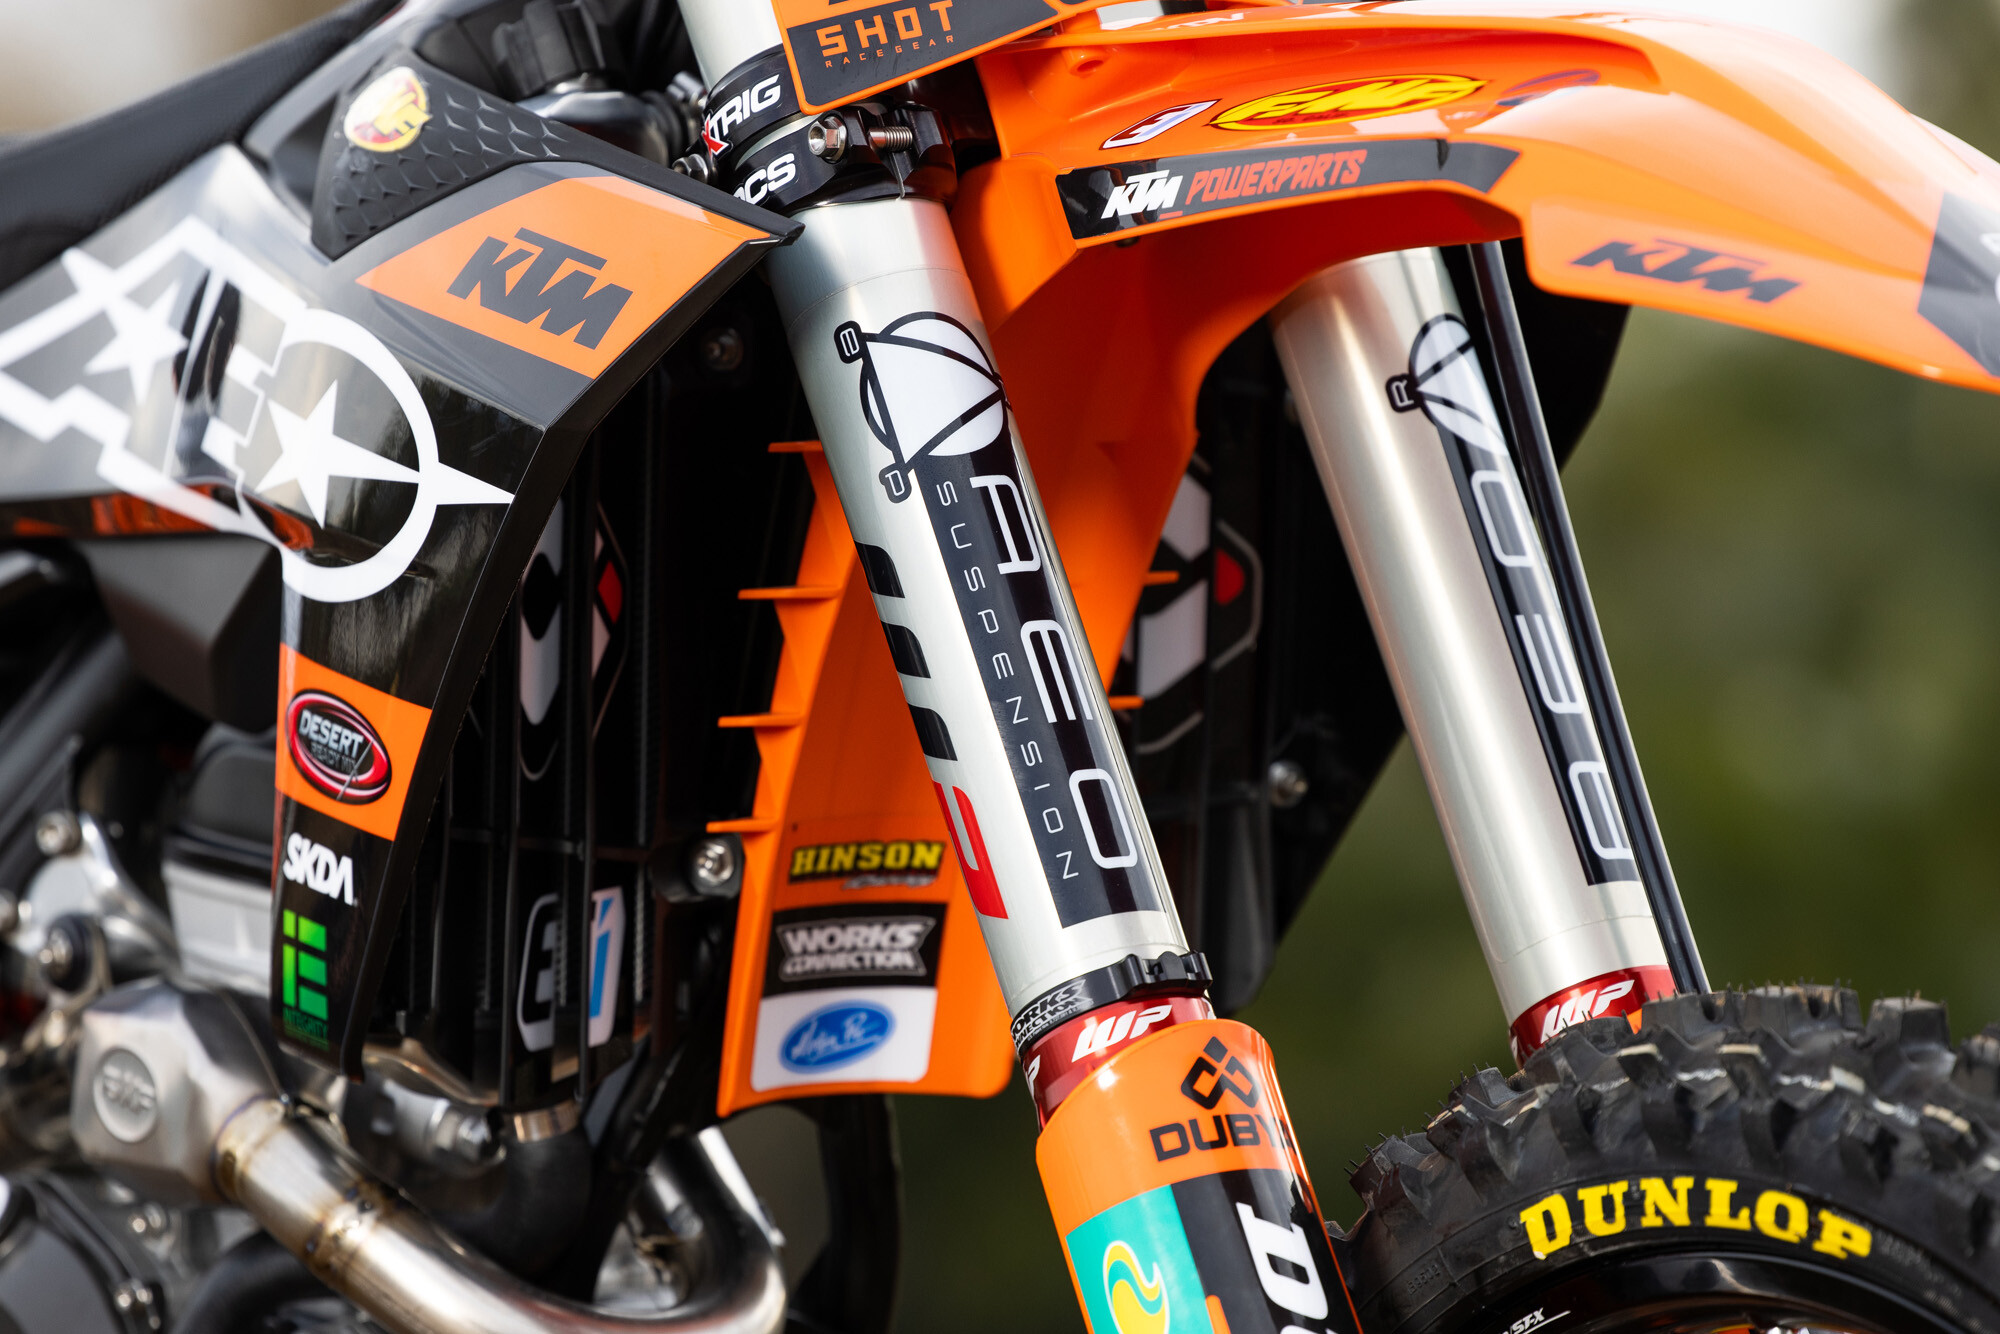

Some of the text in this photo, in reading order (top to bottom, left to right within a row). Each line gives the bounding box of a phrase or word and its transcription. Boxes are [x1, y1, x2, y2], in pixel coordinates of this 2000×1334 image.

[816, 3, 954, 57] SHOT
[825, 35, 954, 68] RACEGEAR
[702, 74, 781, 155] XTRIG
[1101, 149, 1367, 220] KTM POWERPARTS
[446, 227, 634, 350] KTM
[1570, 239, 1803, 304] KTM
[936, 480, 1079, 880] SUSPENSION
[299, 708, 363, 758] DESERT
[282, 831, 355, 906] SKDA
[790, 842, 946, 876] HINSON
[785, 923, 924, 954] WORKS
[785, 951, 914, 974] CONNECTION
[1072, 1005, 1172, 1062] WP
[1540, 979, 1635, 1044] WP
[1520, 1176, 1872, 1260] DUNLOP
